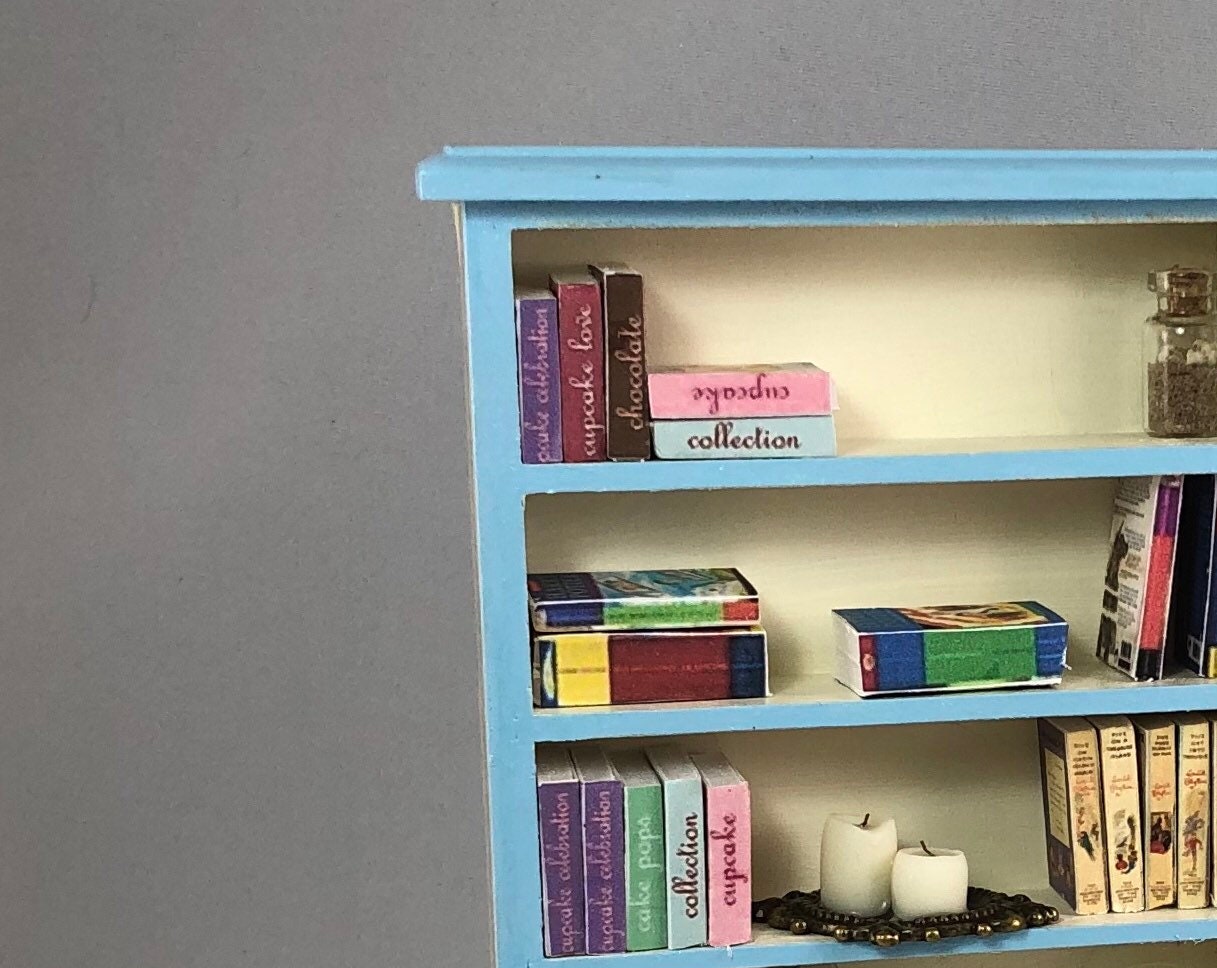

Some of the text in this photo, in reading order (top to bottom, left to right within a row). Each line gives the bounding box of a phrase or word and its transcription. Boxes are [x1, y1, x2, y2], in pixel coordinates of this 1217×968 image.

[568, 303, 604, 457] cupcake love
[615, 314, 643, 431] chocolate
[692, 372, 790, 415] cupcake
[687, 421, 801, 451] collection
[545, 792, 584, 953] cupcake celebration
[587, 790, 625, 951] cupcake celebration
[628, 881, 651, 933] cake
[671, 811, 698, 919] collection
[710, 812, 748, 906] cupcake
